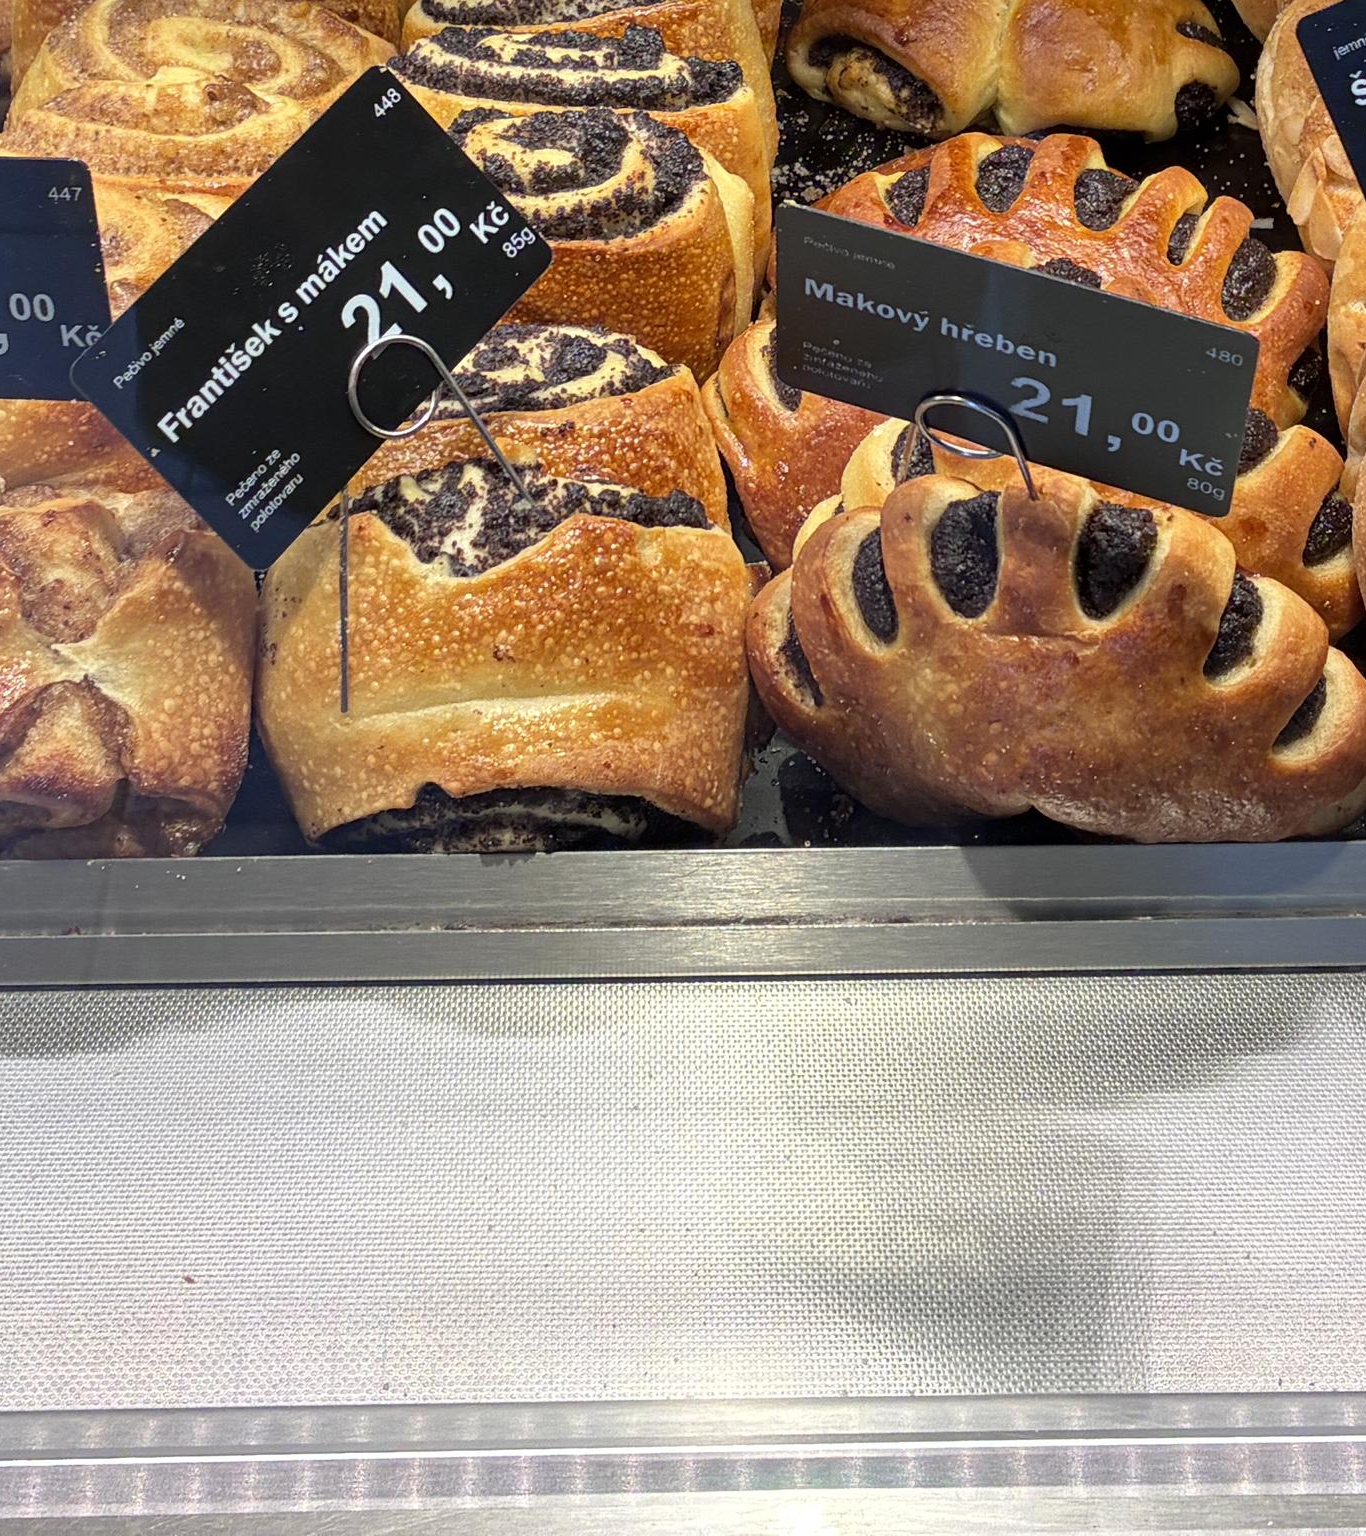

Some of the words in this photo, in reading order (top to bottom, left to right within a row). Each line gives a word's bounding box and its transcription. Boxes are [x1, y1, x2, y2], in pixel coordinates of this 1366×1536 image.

[373, 87, 402, 120] 448
[48, 186, 82, 203] 447
[469, 201, 510, 245] Kč
[502, 225, 537, 259] 85g
[60, 322, 104, 348] Kč
[156, 317, 282, 443] František
[278, 301, 299, 326] s
[295, 209, 389, 306] mákem
[804, 277, 930, 331] Makový
[940, 318, 1059, 368] hřeben
[113, 348, 153, 390] Pečivo
[147, 316, 186, 360] jemné
[1206, 346, 1243, 366] 480
[225, 461, 265, 507] Pečeno
[263, 448, 282, 470] ze
[1178, 448, 1225, 478] Kč
[237, 450, 302, 521] zmraženého
[249, 472, 304, 534] polotovaru
[1186, 477, 1226, 502] 80g
